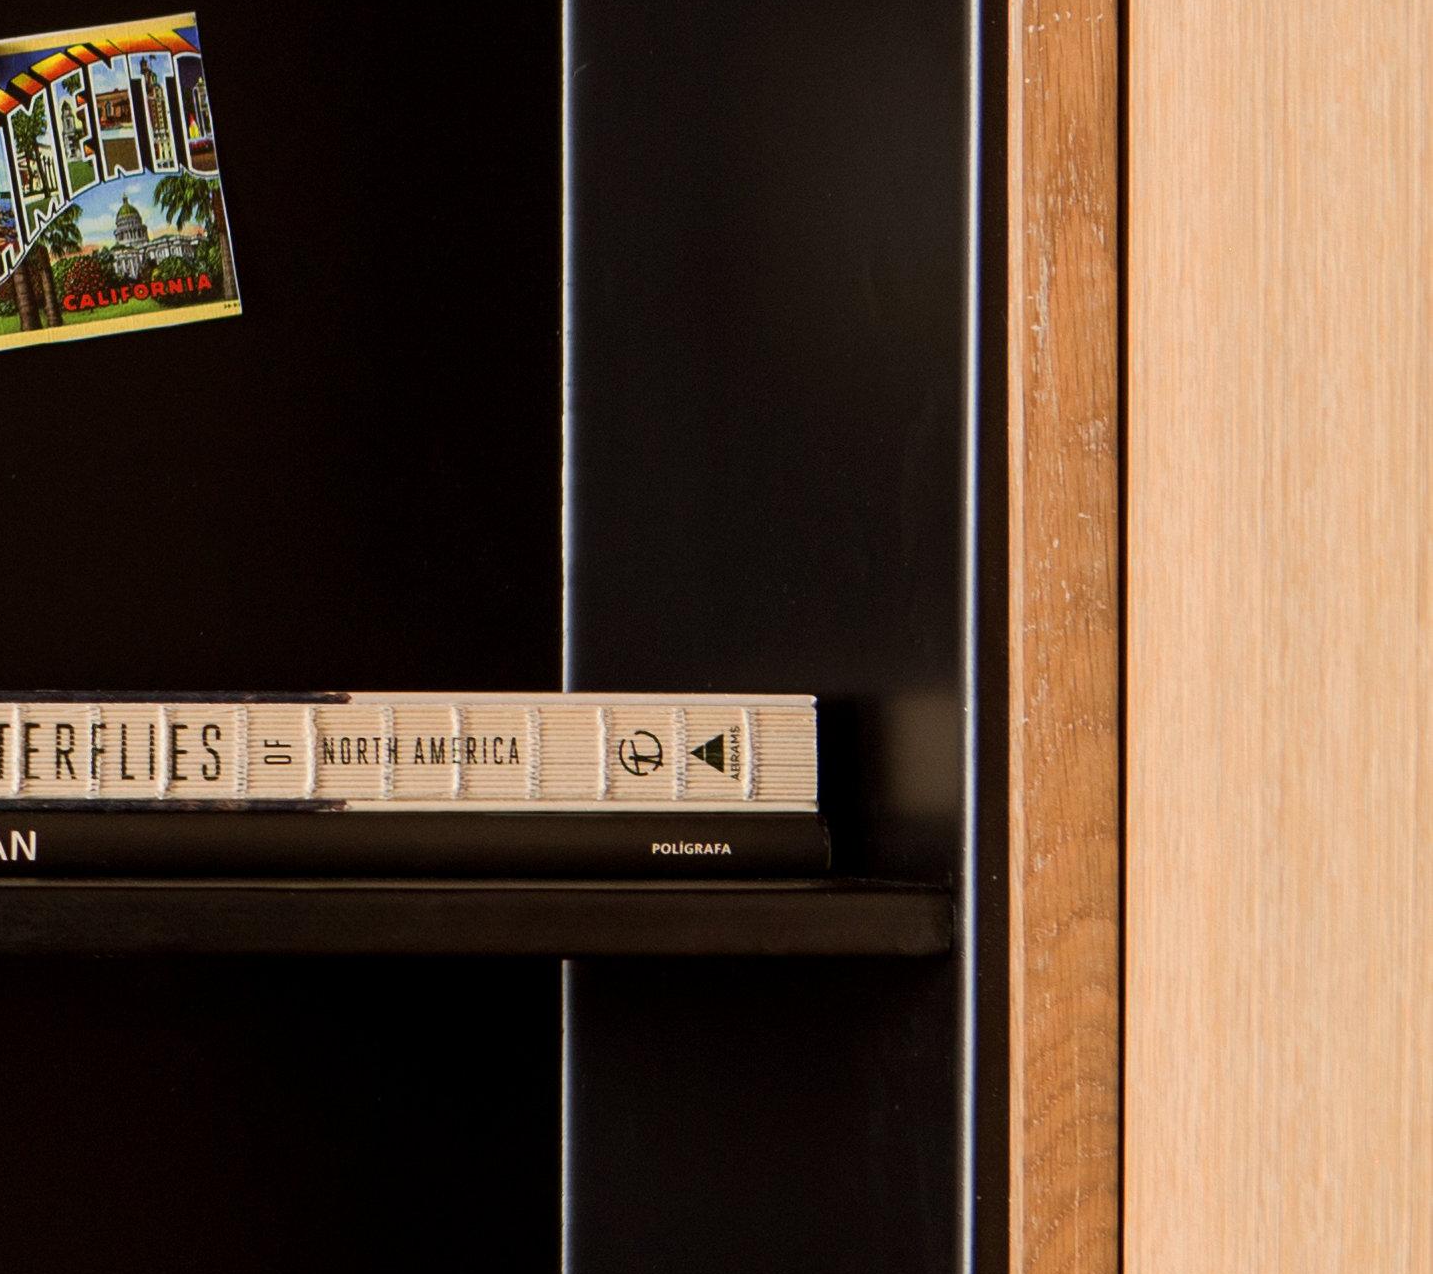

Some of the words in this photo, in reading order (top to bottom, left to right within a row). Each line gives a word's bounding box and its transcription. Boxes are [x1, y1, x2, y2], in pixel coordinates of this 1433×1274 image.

[62, 273, 212, 311] CALIFORNIA
[264, 739, 292, 765] OF
[323, 737, 399, 764] NORTH
[414, 736, 520, 764] AMERICA
[729, 725, 741, 781] ABRAMS
[651, 840, 732, 855] POLÍGRAFA
